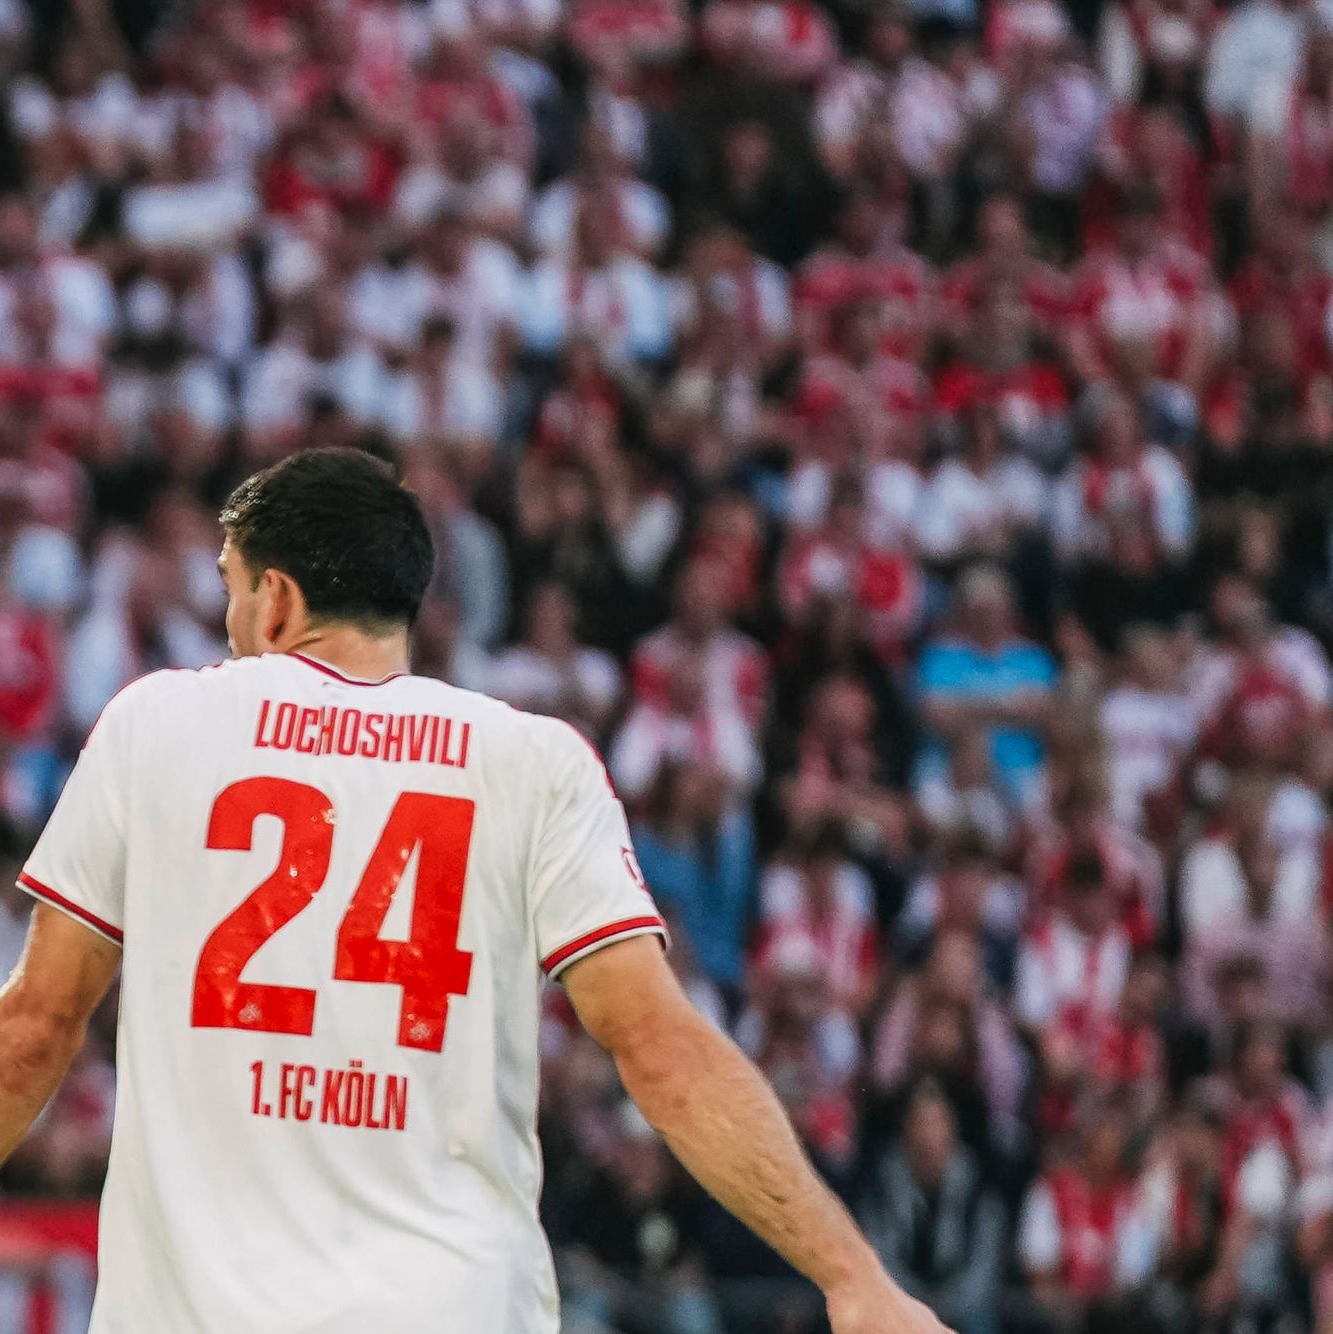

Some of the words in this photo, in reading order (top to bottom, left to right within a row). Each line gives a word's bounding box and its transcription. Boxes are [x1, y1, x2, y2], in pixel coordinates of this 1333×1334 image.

[254, 699, 471, 769] LOCHOSHVILI
[190, 774, 475, 1053] 24
[278, 1063, 316, 1122] FC
[320, 1060, 408, 1131] KÖLN
